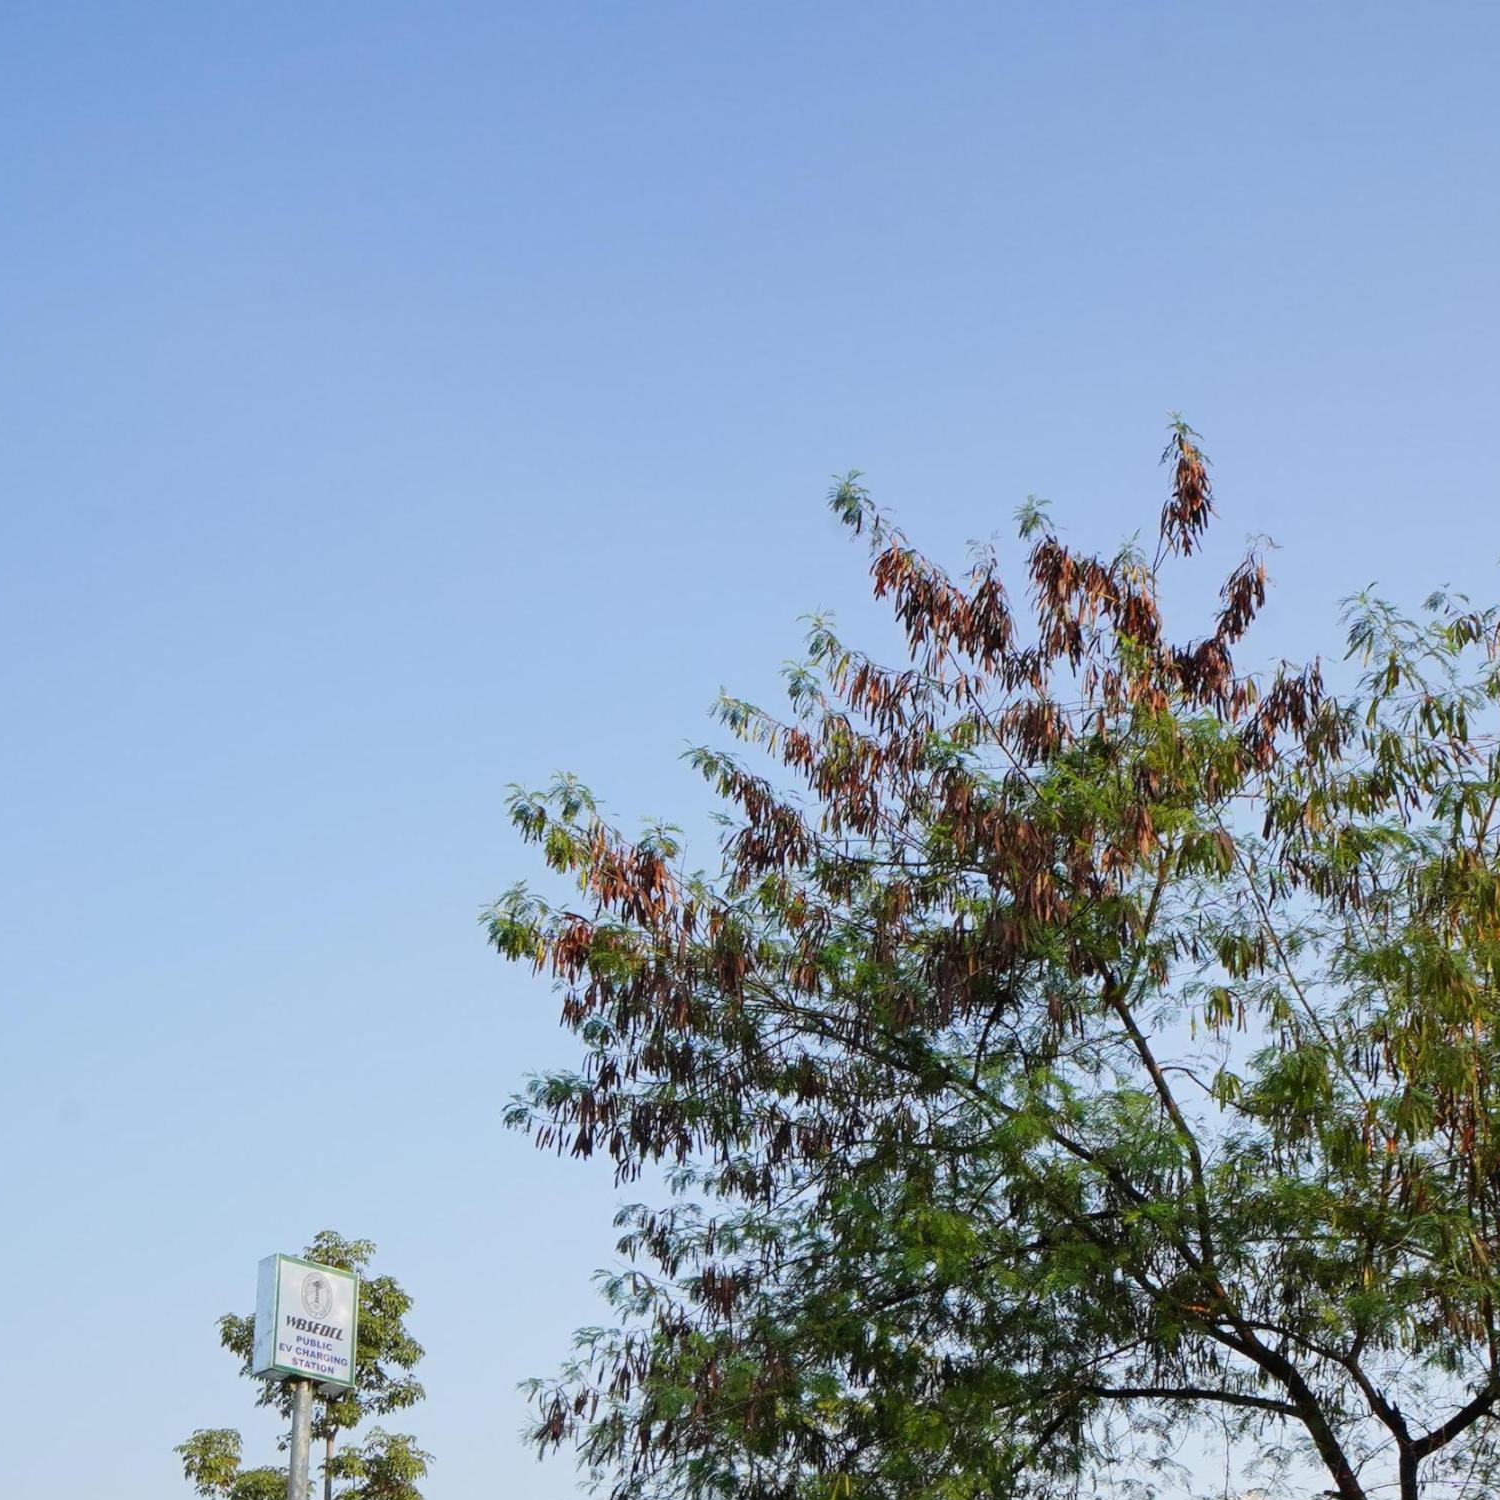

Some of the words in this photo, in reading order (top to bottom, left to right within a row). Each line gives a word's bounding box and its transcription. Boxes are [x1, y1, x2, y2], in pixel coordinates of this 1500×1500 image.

[296, 1335, 332, 1351] PUBLIC
[279, 1343, 292, 1352] EV
[295, 1347, 348, 1366] CHARGING
[291, 1357, 334, 1374] STATION
